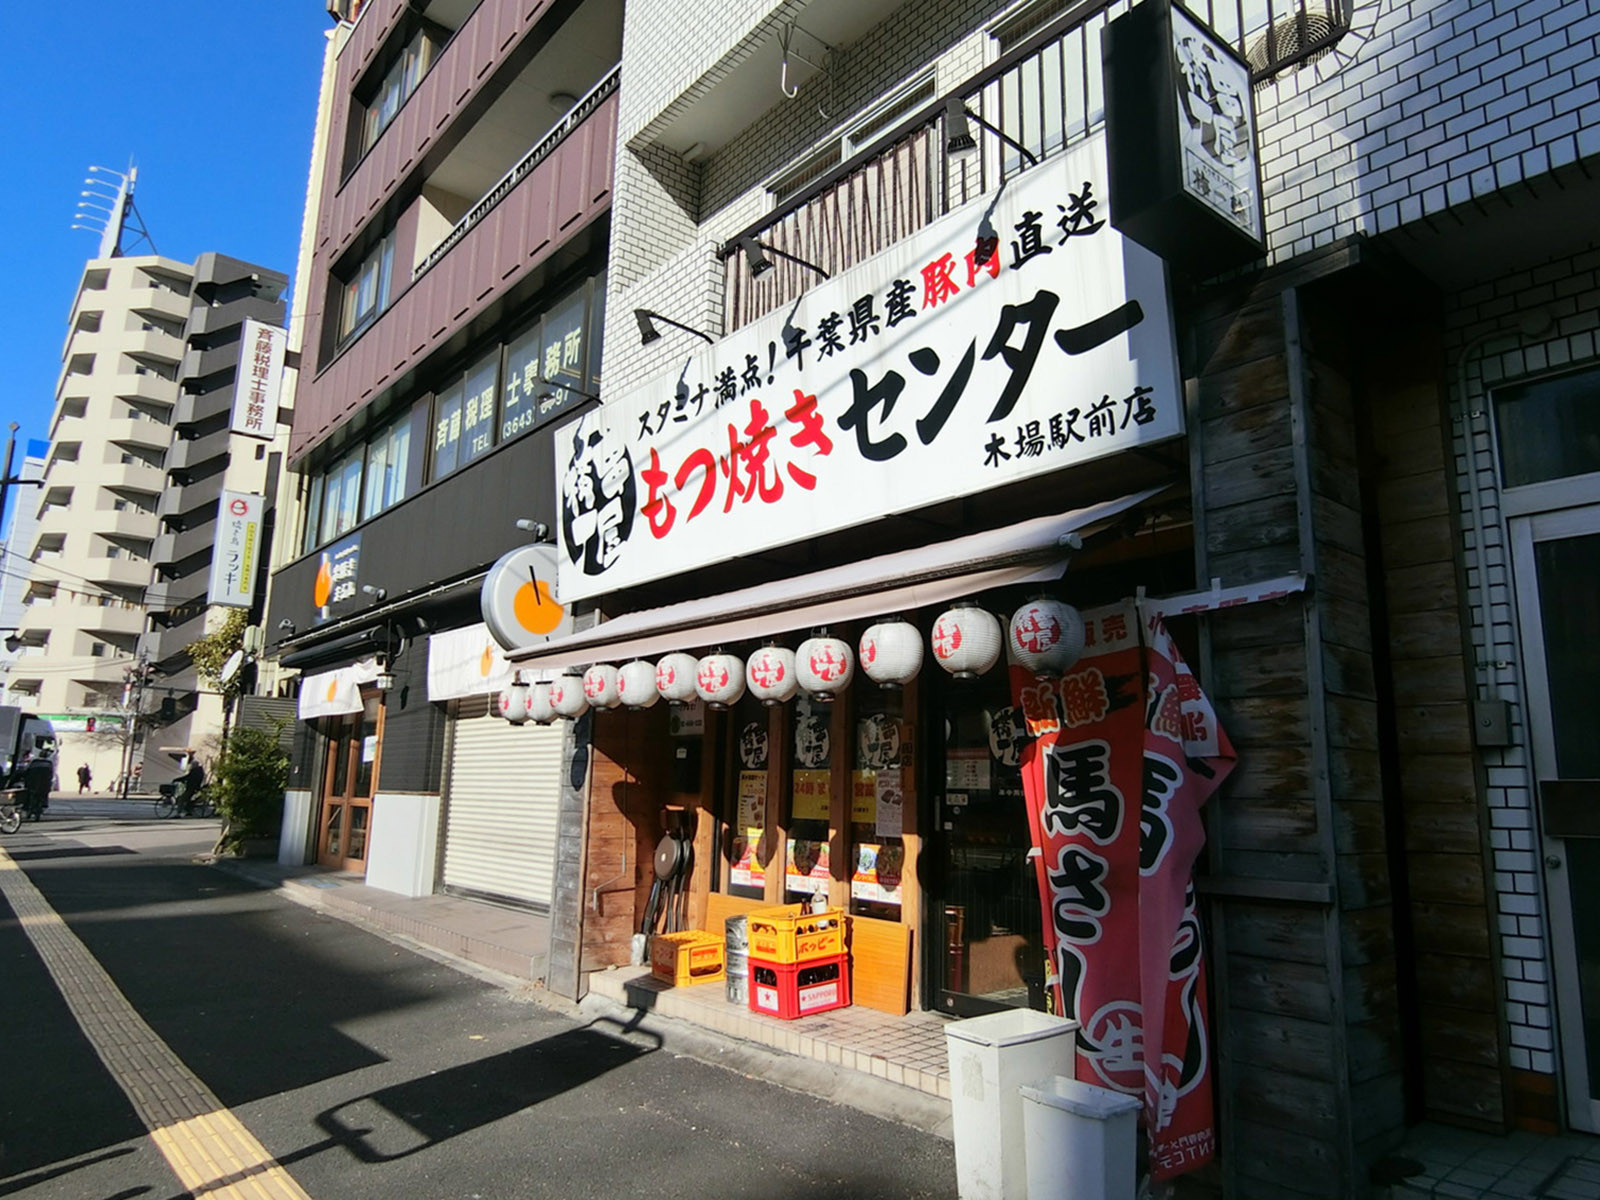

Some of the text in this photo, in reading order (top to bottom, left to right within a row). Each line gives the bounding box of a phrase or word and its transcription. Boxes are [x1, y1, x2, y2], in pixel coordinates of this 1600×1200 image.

[472, 436, 489, 454] TEL
[640, 288, 1146, 540] もつ焼きセンター
[984, 386, 1156, 467] 木場駅前店
[224, 549, 240, 596] ラッキー
[1021, 668, 1109, 737] 新鮮
[1043, 743, 1123, 1056] 馬さし
[799, 936, 836, 954] ホッピー
